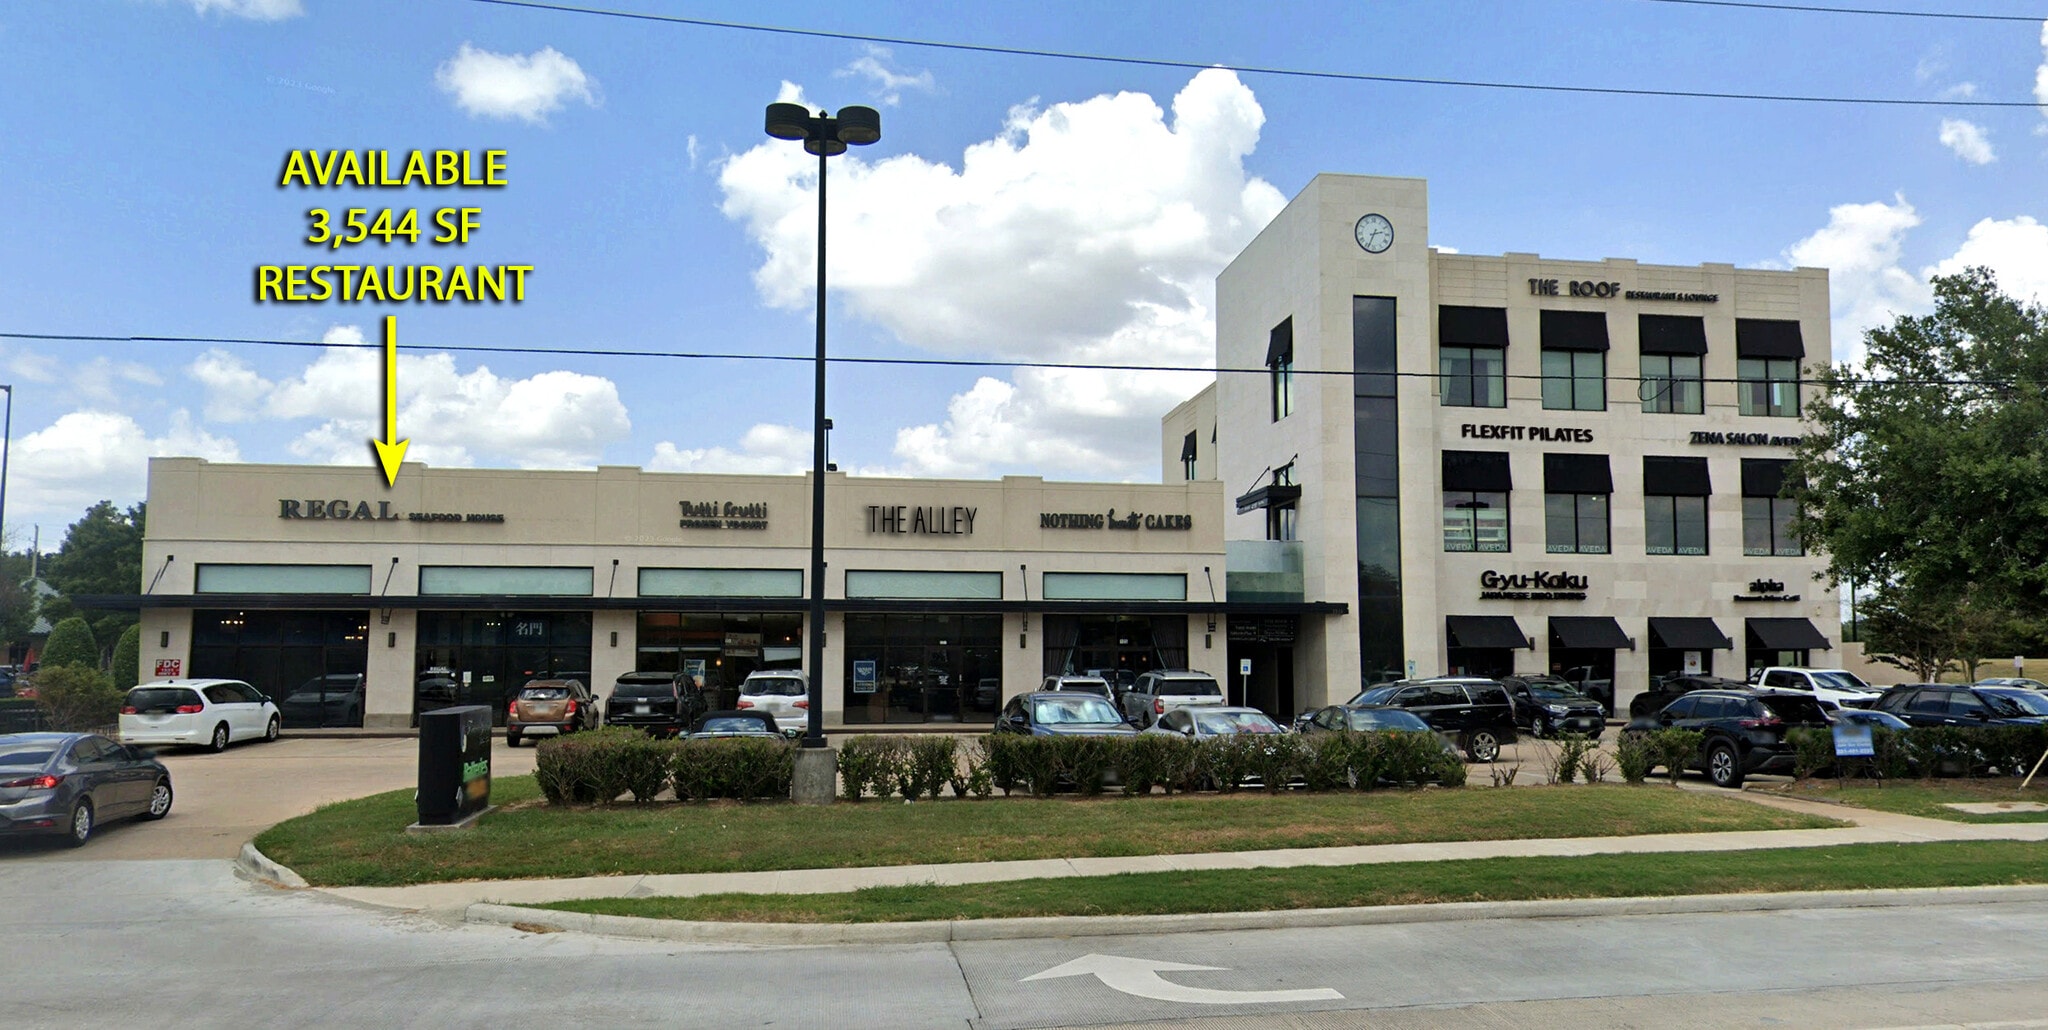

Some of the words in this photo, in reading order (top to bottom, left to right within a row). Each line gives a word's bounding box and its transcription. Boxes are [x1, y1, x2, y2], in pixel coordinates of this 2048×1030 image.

[1528, 278, 1559, 295] THE
[1569, 280, 1620, 298] ROOF
[1461, 424, 1525, 440] FLEXFIT
[1528, 426, 1594, 443] PILATES
[1690, 431, 1725, 445] ZENA
[1726, 432, 1769, 446] SALON
[278, 499, 399, 521] REGAL
[408, 512, 463, 523] SEAFOOD
[466, 513, 505, 524] HOUSE
[679, 501, 718, 518] Tutti
[868, 506, 907, 533] THE
[914, 506, 978, 534] ALLEY
[1040, 512, 1104, 529] NOTHING
[1145, 514, 1192, 530] CAKES
[1481, 570, 1589, 590] Gyu-Kaku
[1749, 578, 1785, 593] alpha
[156, 660, 180, 668] FDC
